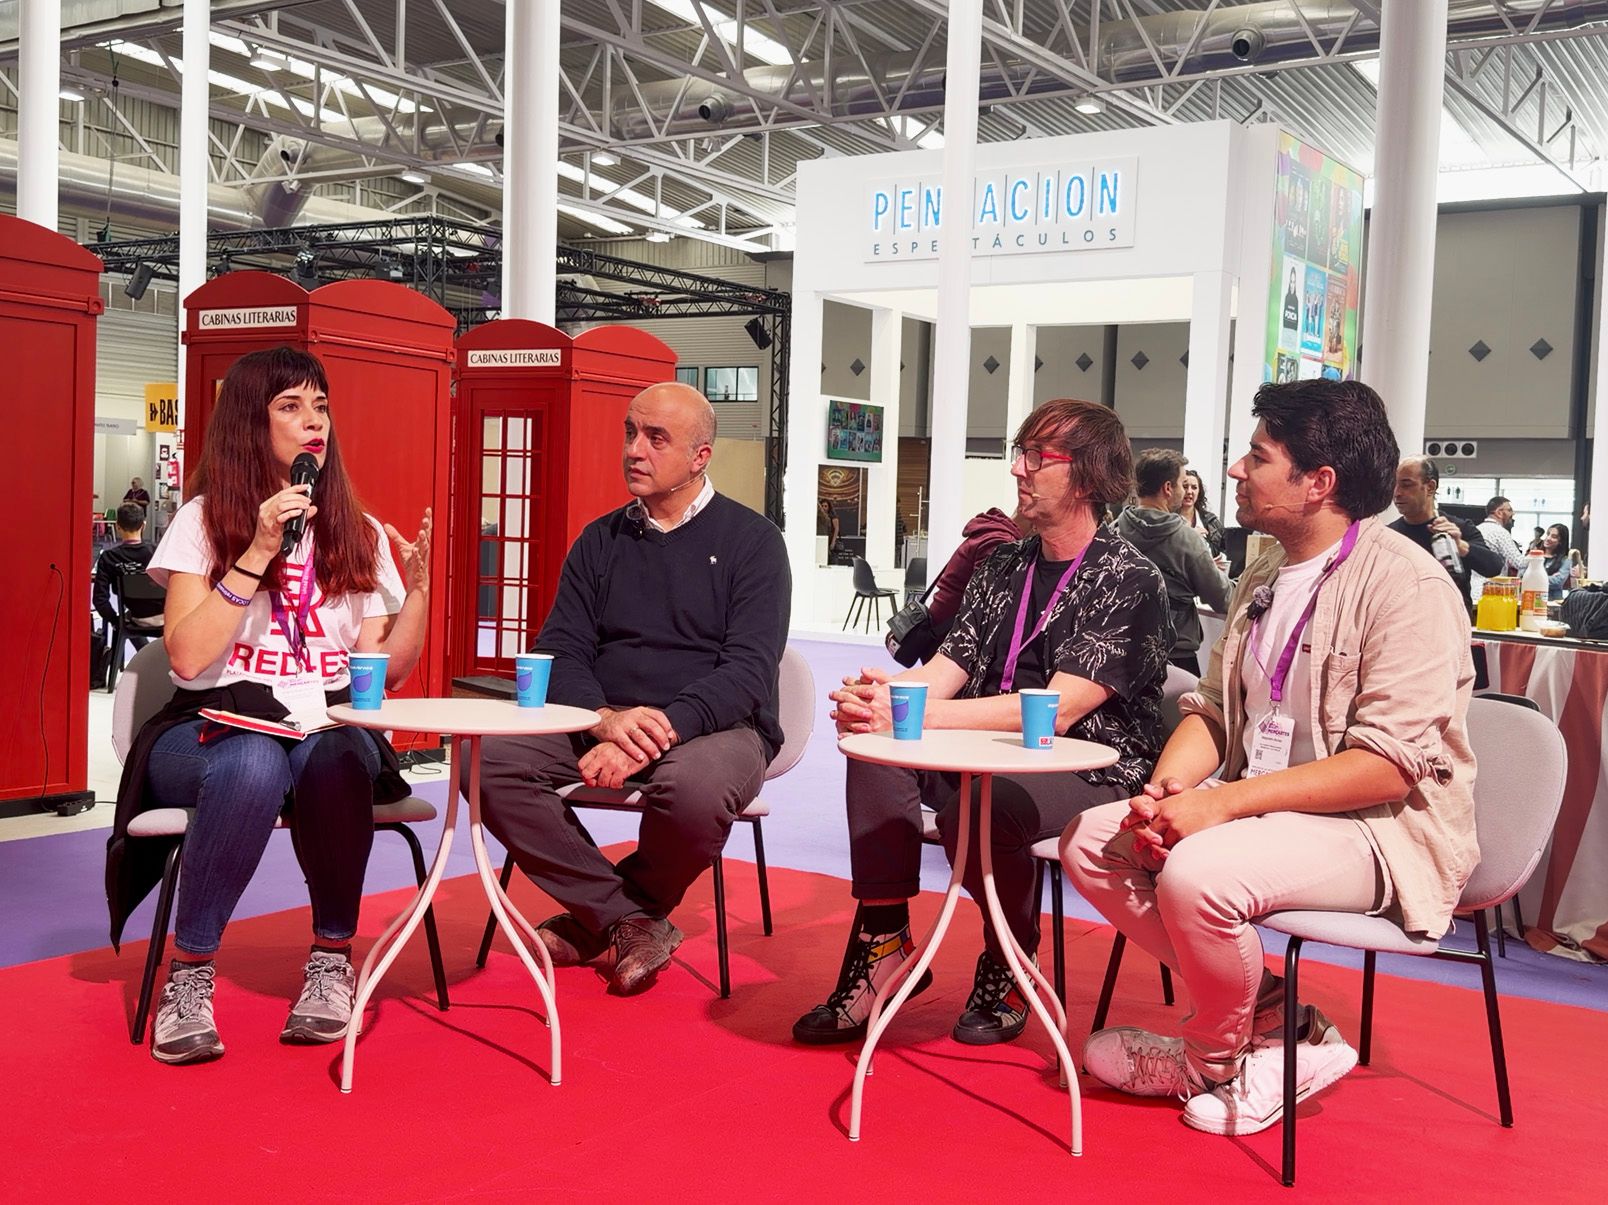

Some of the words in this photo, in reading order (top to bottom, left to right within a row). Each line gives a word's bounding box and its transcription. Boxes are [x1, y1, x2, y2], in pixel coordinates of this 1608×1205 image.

[873, 171, 1119, 231] PENACION
[873, 228, 1117, 256] ESPETÁCULOS
[202, 312, 241, 326] CABINAS
[243, 309, 296, 324] LITERARIAS
[470, 353, 508, 364] CABINAS
[509, 352, 559, 364] LITERARIAS
